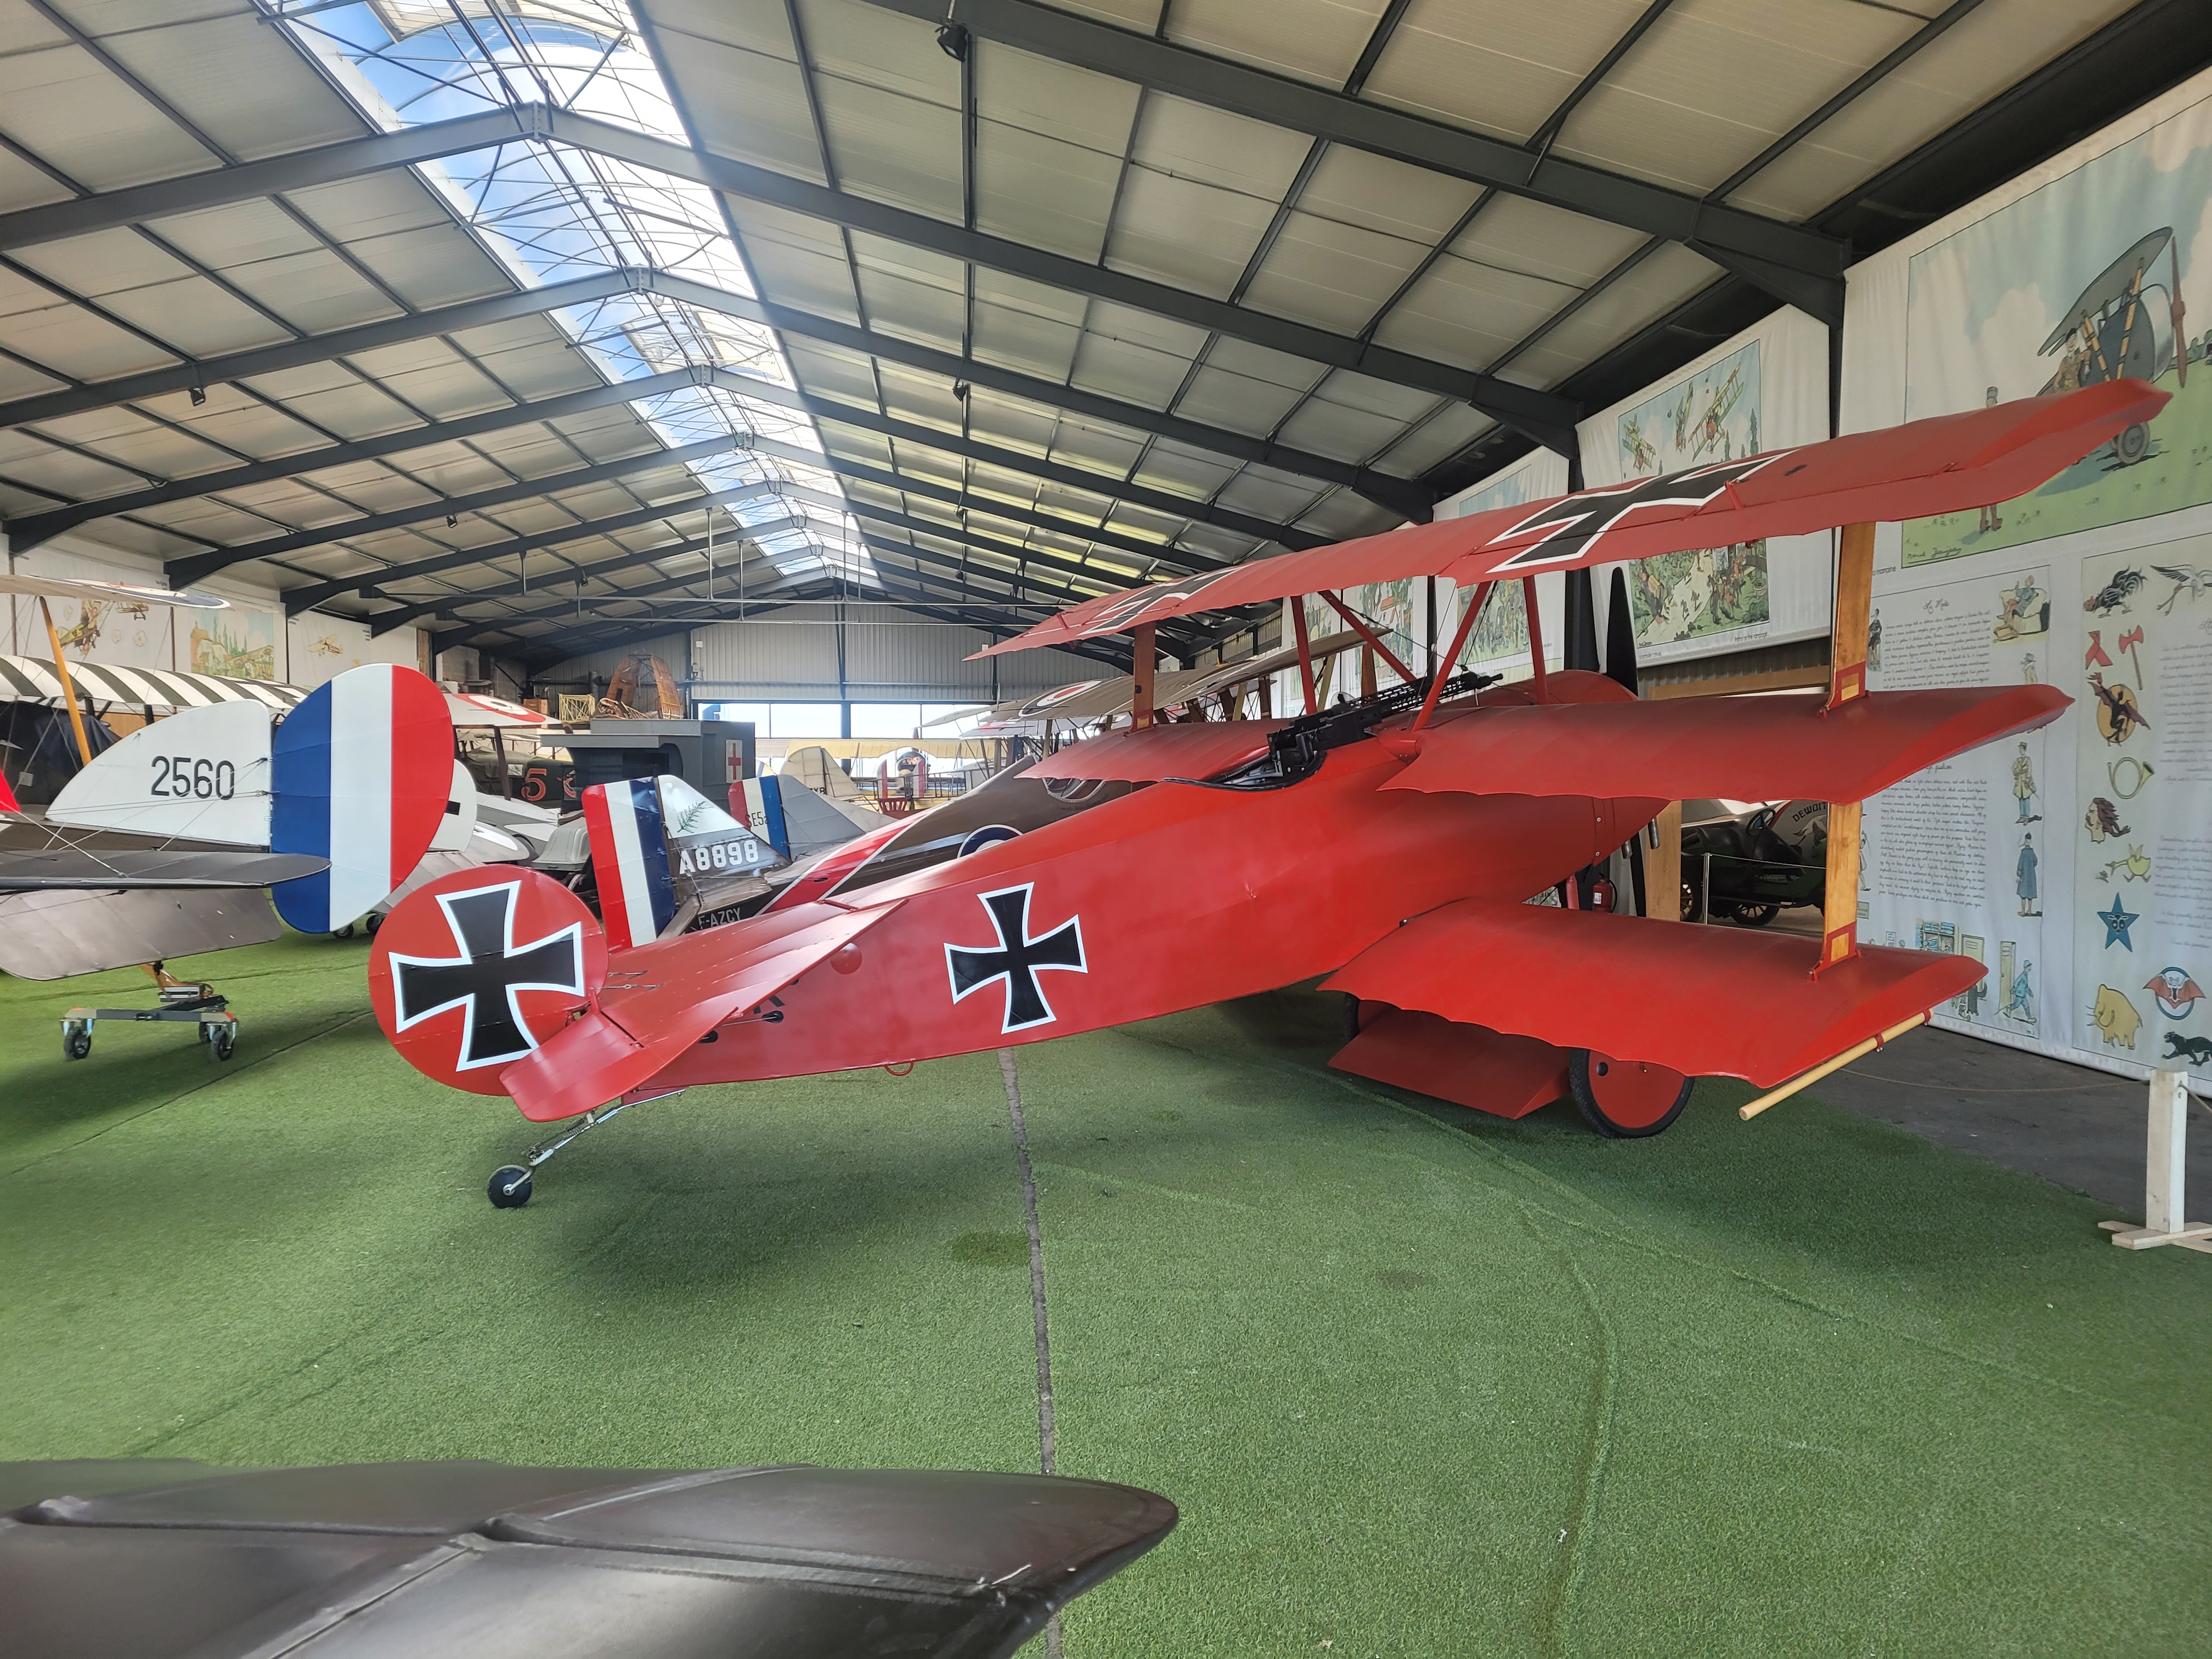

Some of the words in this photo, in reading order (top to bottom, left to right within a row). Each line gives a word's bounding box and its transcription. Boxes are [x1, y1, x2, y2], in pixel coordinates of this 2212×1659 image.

[151, 755, 234, 800] 2560
[521, 768, 547, 801] 5
[745, 811, 769, 827] SE5a
[1792, 802, 1826, 822] DEWOIT
[679, 839, 759, 874] A8898
[698, 907, 741, 929] F-AZCY
